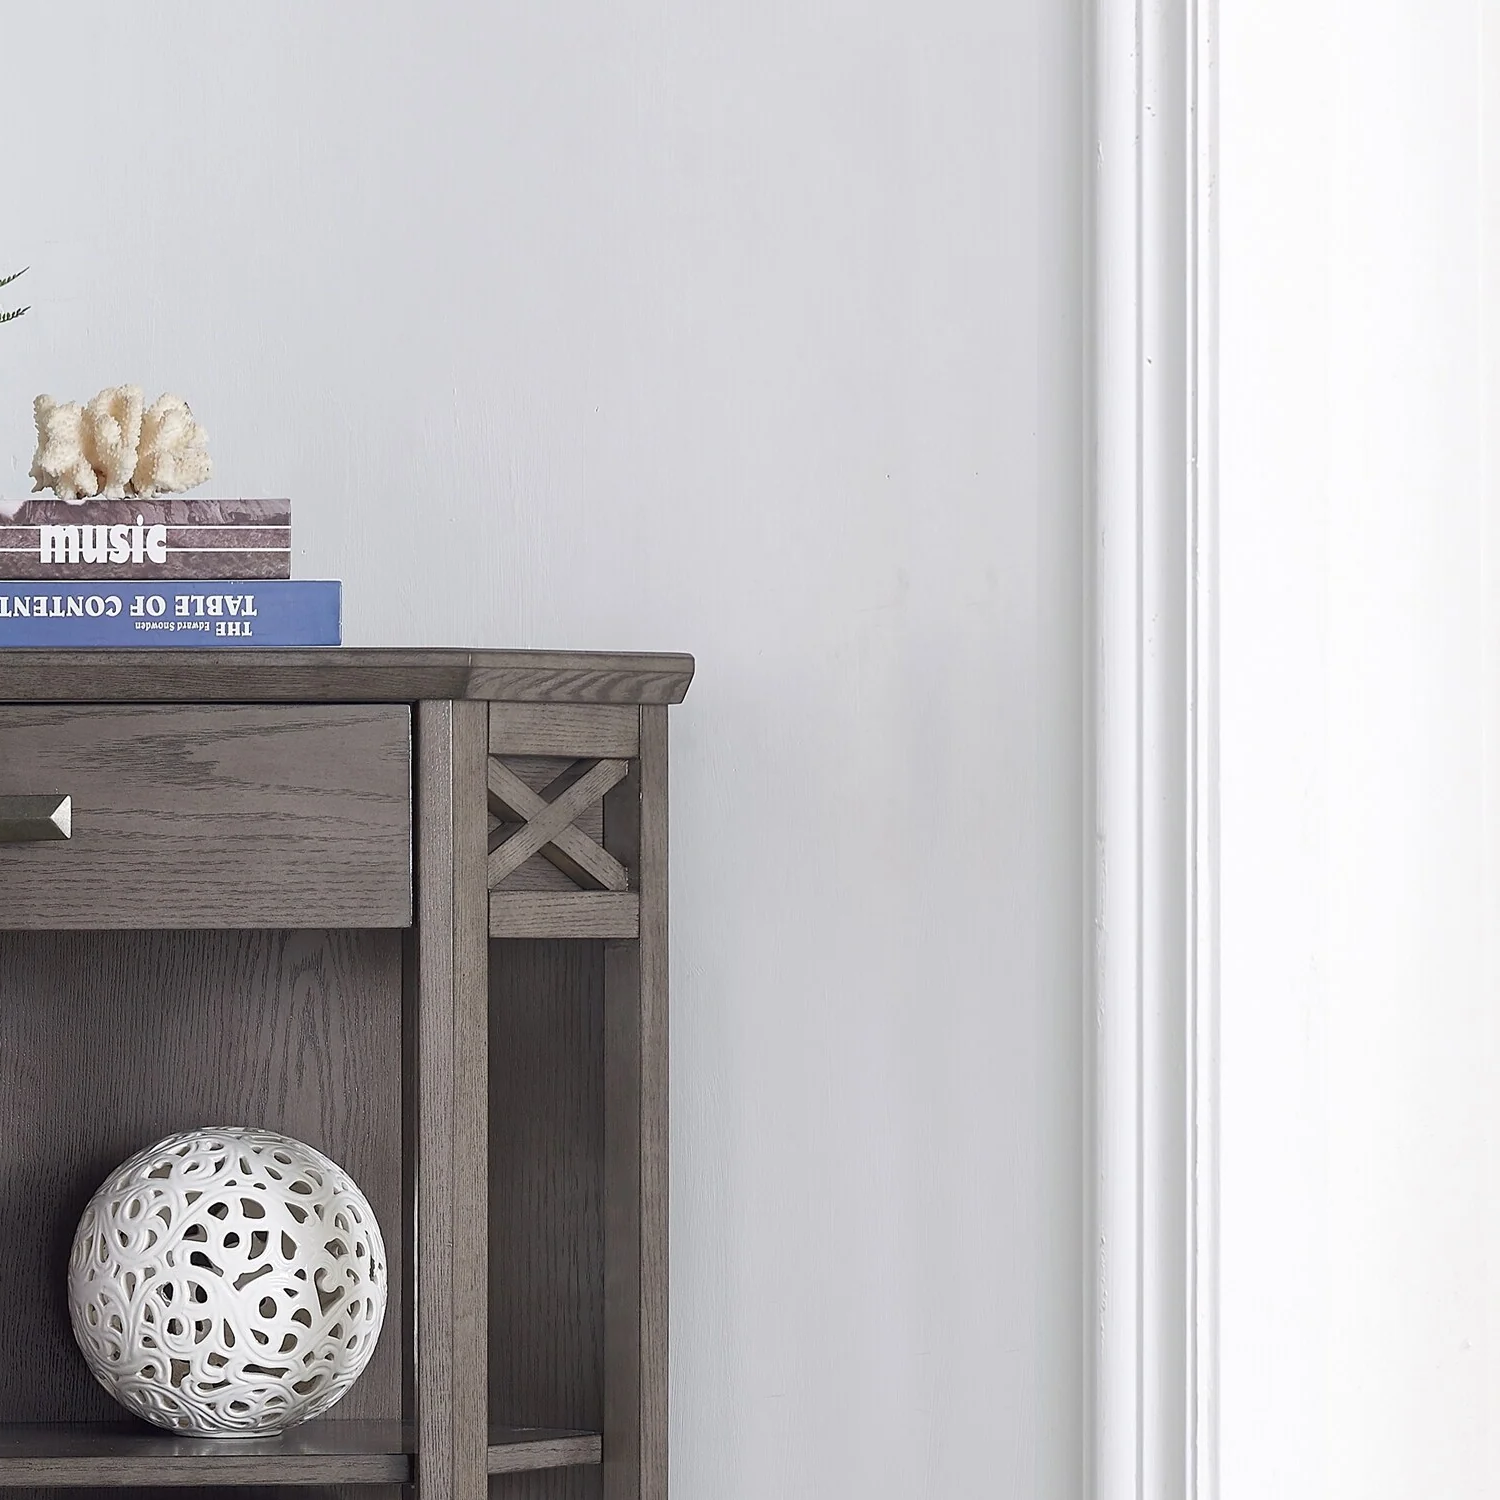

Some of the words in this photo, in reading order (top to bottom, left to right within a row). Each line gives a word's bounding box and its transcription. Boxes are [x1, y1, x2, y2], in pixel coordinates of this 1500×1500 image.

[40, 514, 168, 564] music
[129, 594, 167, 617] OF
[174, 595, 257, 617] TABLE
[134, 621, 175, 631] Snowden
[177, 621, 210, 631] Edward
[215, 621, 252, 637] THE
